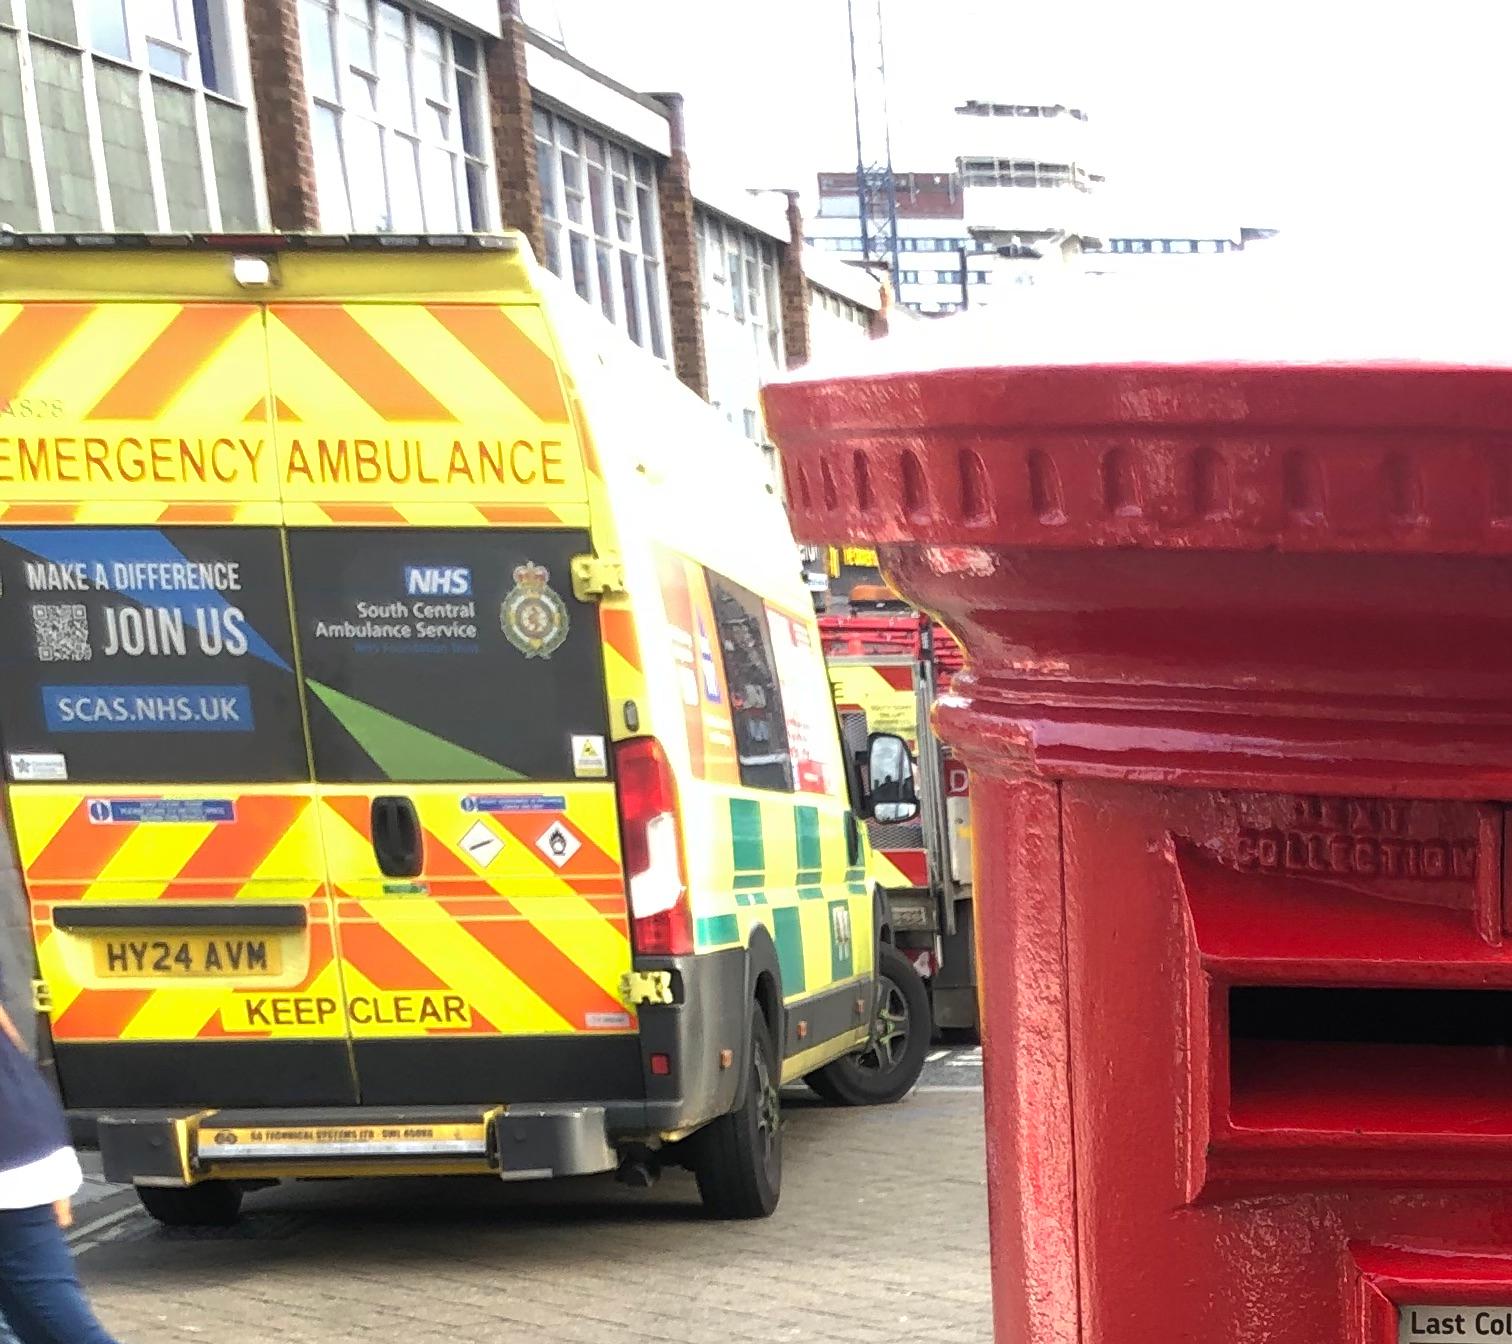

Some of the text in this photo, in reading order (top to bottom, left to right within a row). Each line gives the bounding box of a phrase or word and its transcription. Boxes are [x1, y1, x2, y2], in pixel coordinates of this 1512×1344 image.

[0, 437, 565, 484] EMERGENCY AMBULANCE
[26, 562, 242, 591] MAKE A DIFFERENCE
[407, 568, 470, 595] NHS
[357, 602, 475, 619] South Central
[103, 606, 249, 656] JOIN US
[315, 621, 477, 639] Ambulance Service
[57, 698, 240, 721] SCAS.NHS.UK
[107, 942, 268, 971] HY24 AVM
[246, 995, 468, 1026] KEEP CLEAR
[1410, 1311, 1466, 1335] Last
